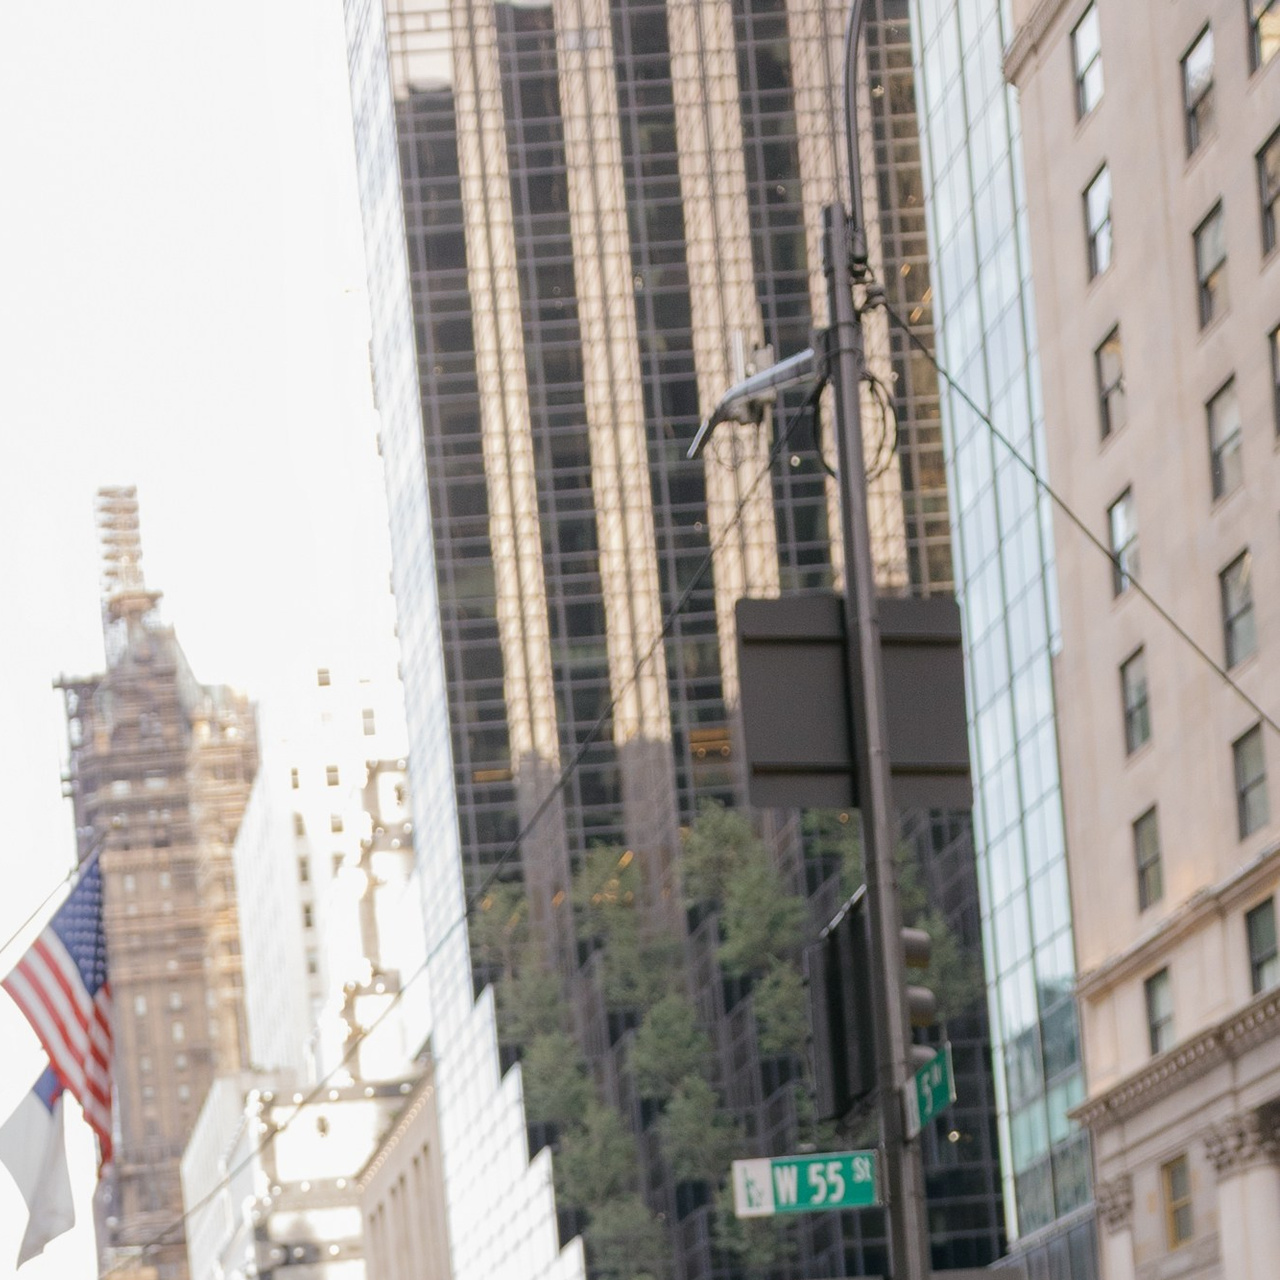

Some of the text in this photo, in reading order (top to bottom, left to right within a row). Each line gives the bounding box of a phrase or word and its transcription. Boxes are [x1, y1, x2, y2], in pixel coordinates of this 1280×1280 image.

[773, 1155, 871, 1206] W 55 St
